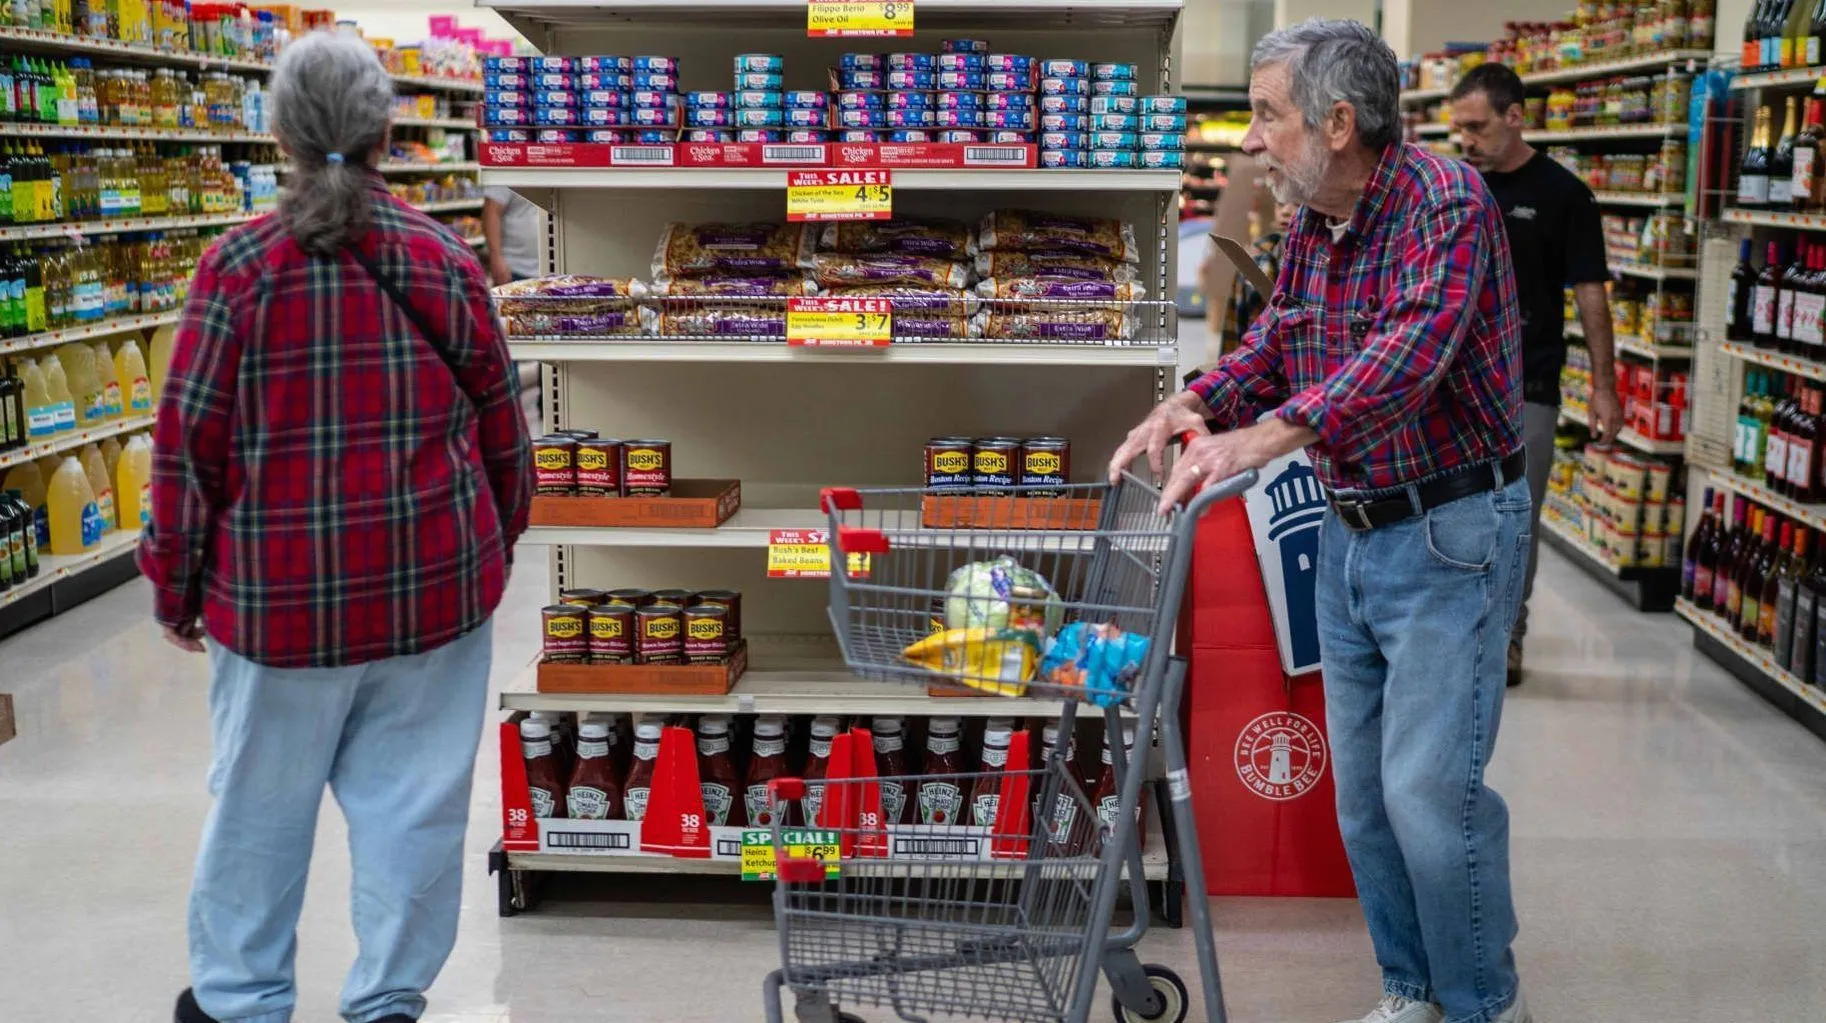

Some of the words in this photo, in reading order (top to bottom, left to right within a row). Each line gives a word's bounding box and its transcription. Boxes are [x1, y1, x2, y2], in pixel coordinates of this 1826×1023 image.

[812, 5, 841, 13] Filippo
[812, 15, 834, 23] Olive
[837, 15, 849, 23] Oil
[488, 146, 521, 155] Chicken
[690, 146, 720, 155] Chicken
[841, 146, 873, 156] Chicken
[826, 171, 887, 185] SALE!
[855, 185, 868, 202] 4
[827, 300, 886, 312] SALE!
[855, 313, 866, 330] 3
[537, 453, 569, 465] BUSH'S
[630, 453, 661, 465] BUSH'S
[936, 456, 967, 468] BUSH'S
[975, 456, 1005, 468] BUSH'S
[1027, 457, 1059, 468] BUSH'S
[577, 471, 610, 482] omestyle
[626, 472, 666, 482] Homestyle
[930, 474, 952, 484] Boston
[953, 474, 971, 484] Recip
[989, 474, 1012, 485] Recipe
[799, 556, 824, 564] Beans
[550, 621, 580, 632] BUSH'S
[649, 623, 680, 633] BUSH'S
[690, 623, 722, 634] BUSH'S
[1251, 716, 1283, 735] WELL
[1285, 718, 1308, 733] FOR
[1306, 731, 1321, 759] LIFE
[1240, 764, 1293, 796] BUMBLE
[1293, 765, 1318, 792] BEE
[576, 791, 600, 801] HEINZ
[634, 791, 647, 800] HEI
[753, 788, 768, 797] HEI
[928, 787, 953, 797] HEINZ
[576, 800, 599, 809] TOMATO
[508, 808, 528, 822] 38
[680, 813, 700, 828] 38
[860, 812, 878, 826] 38
[746, 831, 835, 845] SPCIAL!
